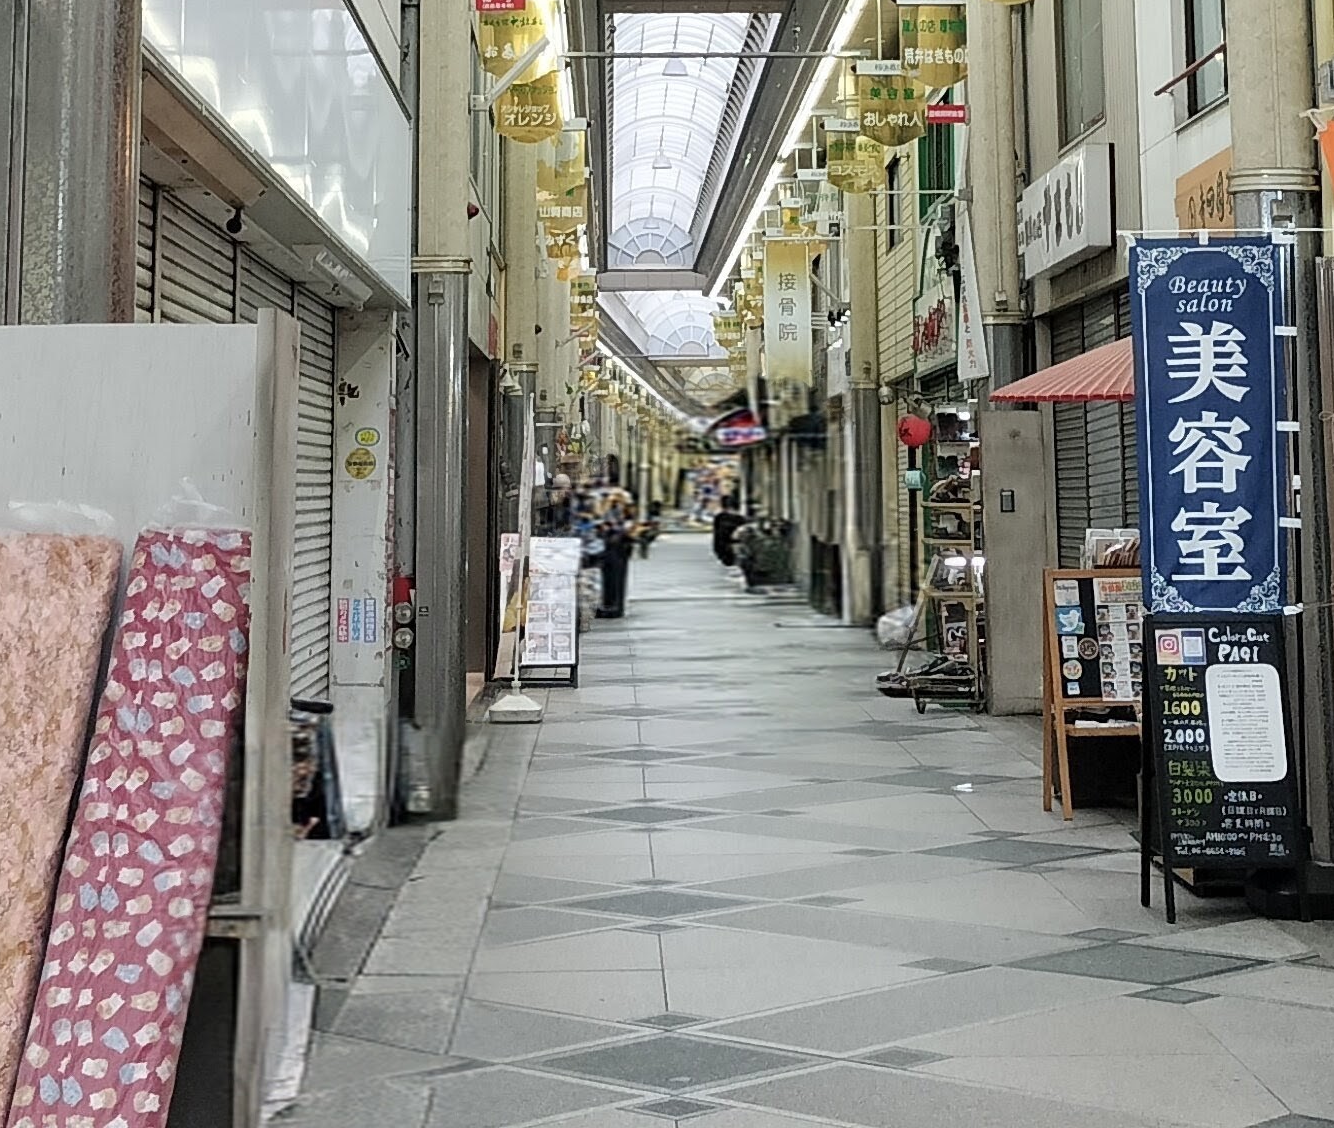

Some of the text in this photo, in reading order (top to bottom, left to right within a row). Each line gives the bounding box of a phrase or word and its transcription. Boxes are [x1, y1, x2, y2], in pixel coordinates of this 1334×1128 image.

[504, 113, 557, 126] オレンジ
[863, 111, 923, 127] おしゃれ人
[1167, 275, 1247, 300] Beauty
[778, 272, 798, 342] 接骨院
[1175, 292, 1234, 314] salon
[1166, 320, 1252, 582] 美容室
